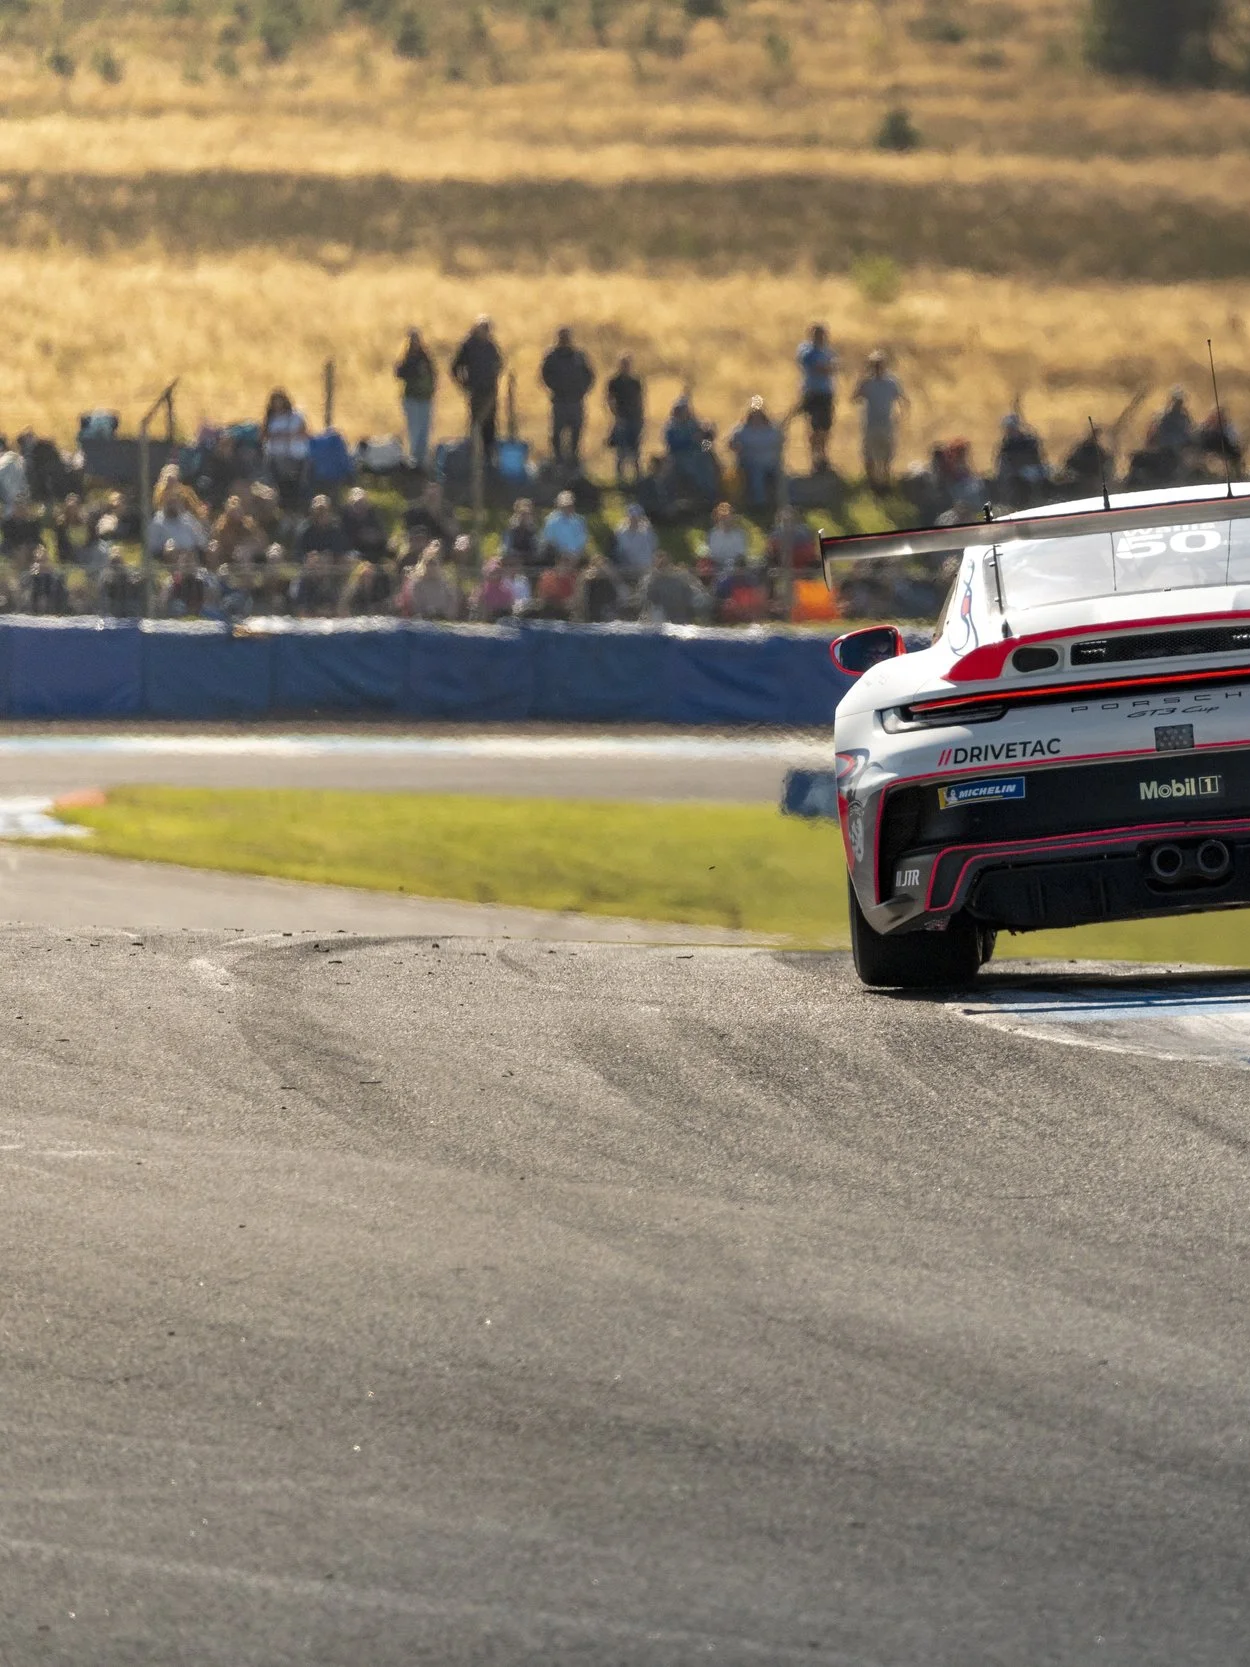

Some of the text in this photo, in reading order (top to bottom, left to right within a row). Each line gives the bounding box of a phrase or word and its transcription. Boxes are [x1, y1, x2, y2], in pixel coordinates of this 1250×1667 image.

[1116, 530, 1221, 559] 50
[1127, 705, 1220, 718] GT3 Cup
[958, 784, 1017, 798] MICHELIN
[1139, 778, 1197, 800] Mobil
